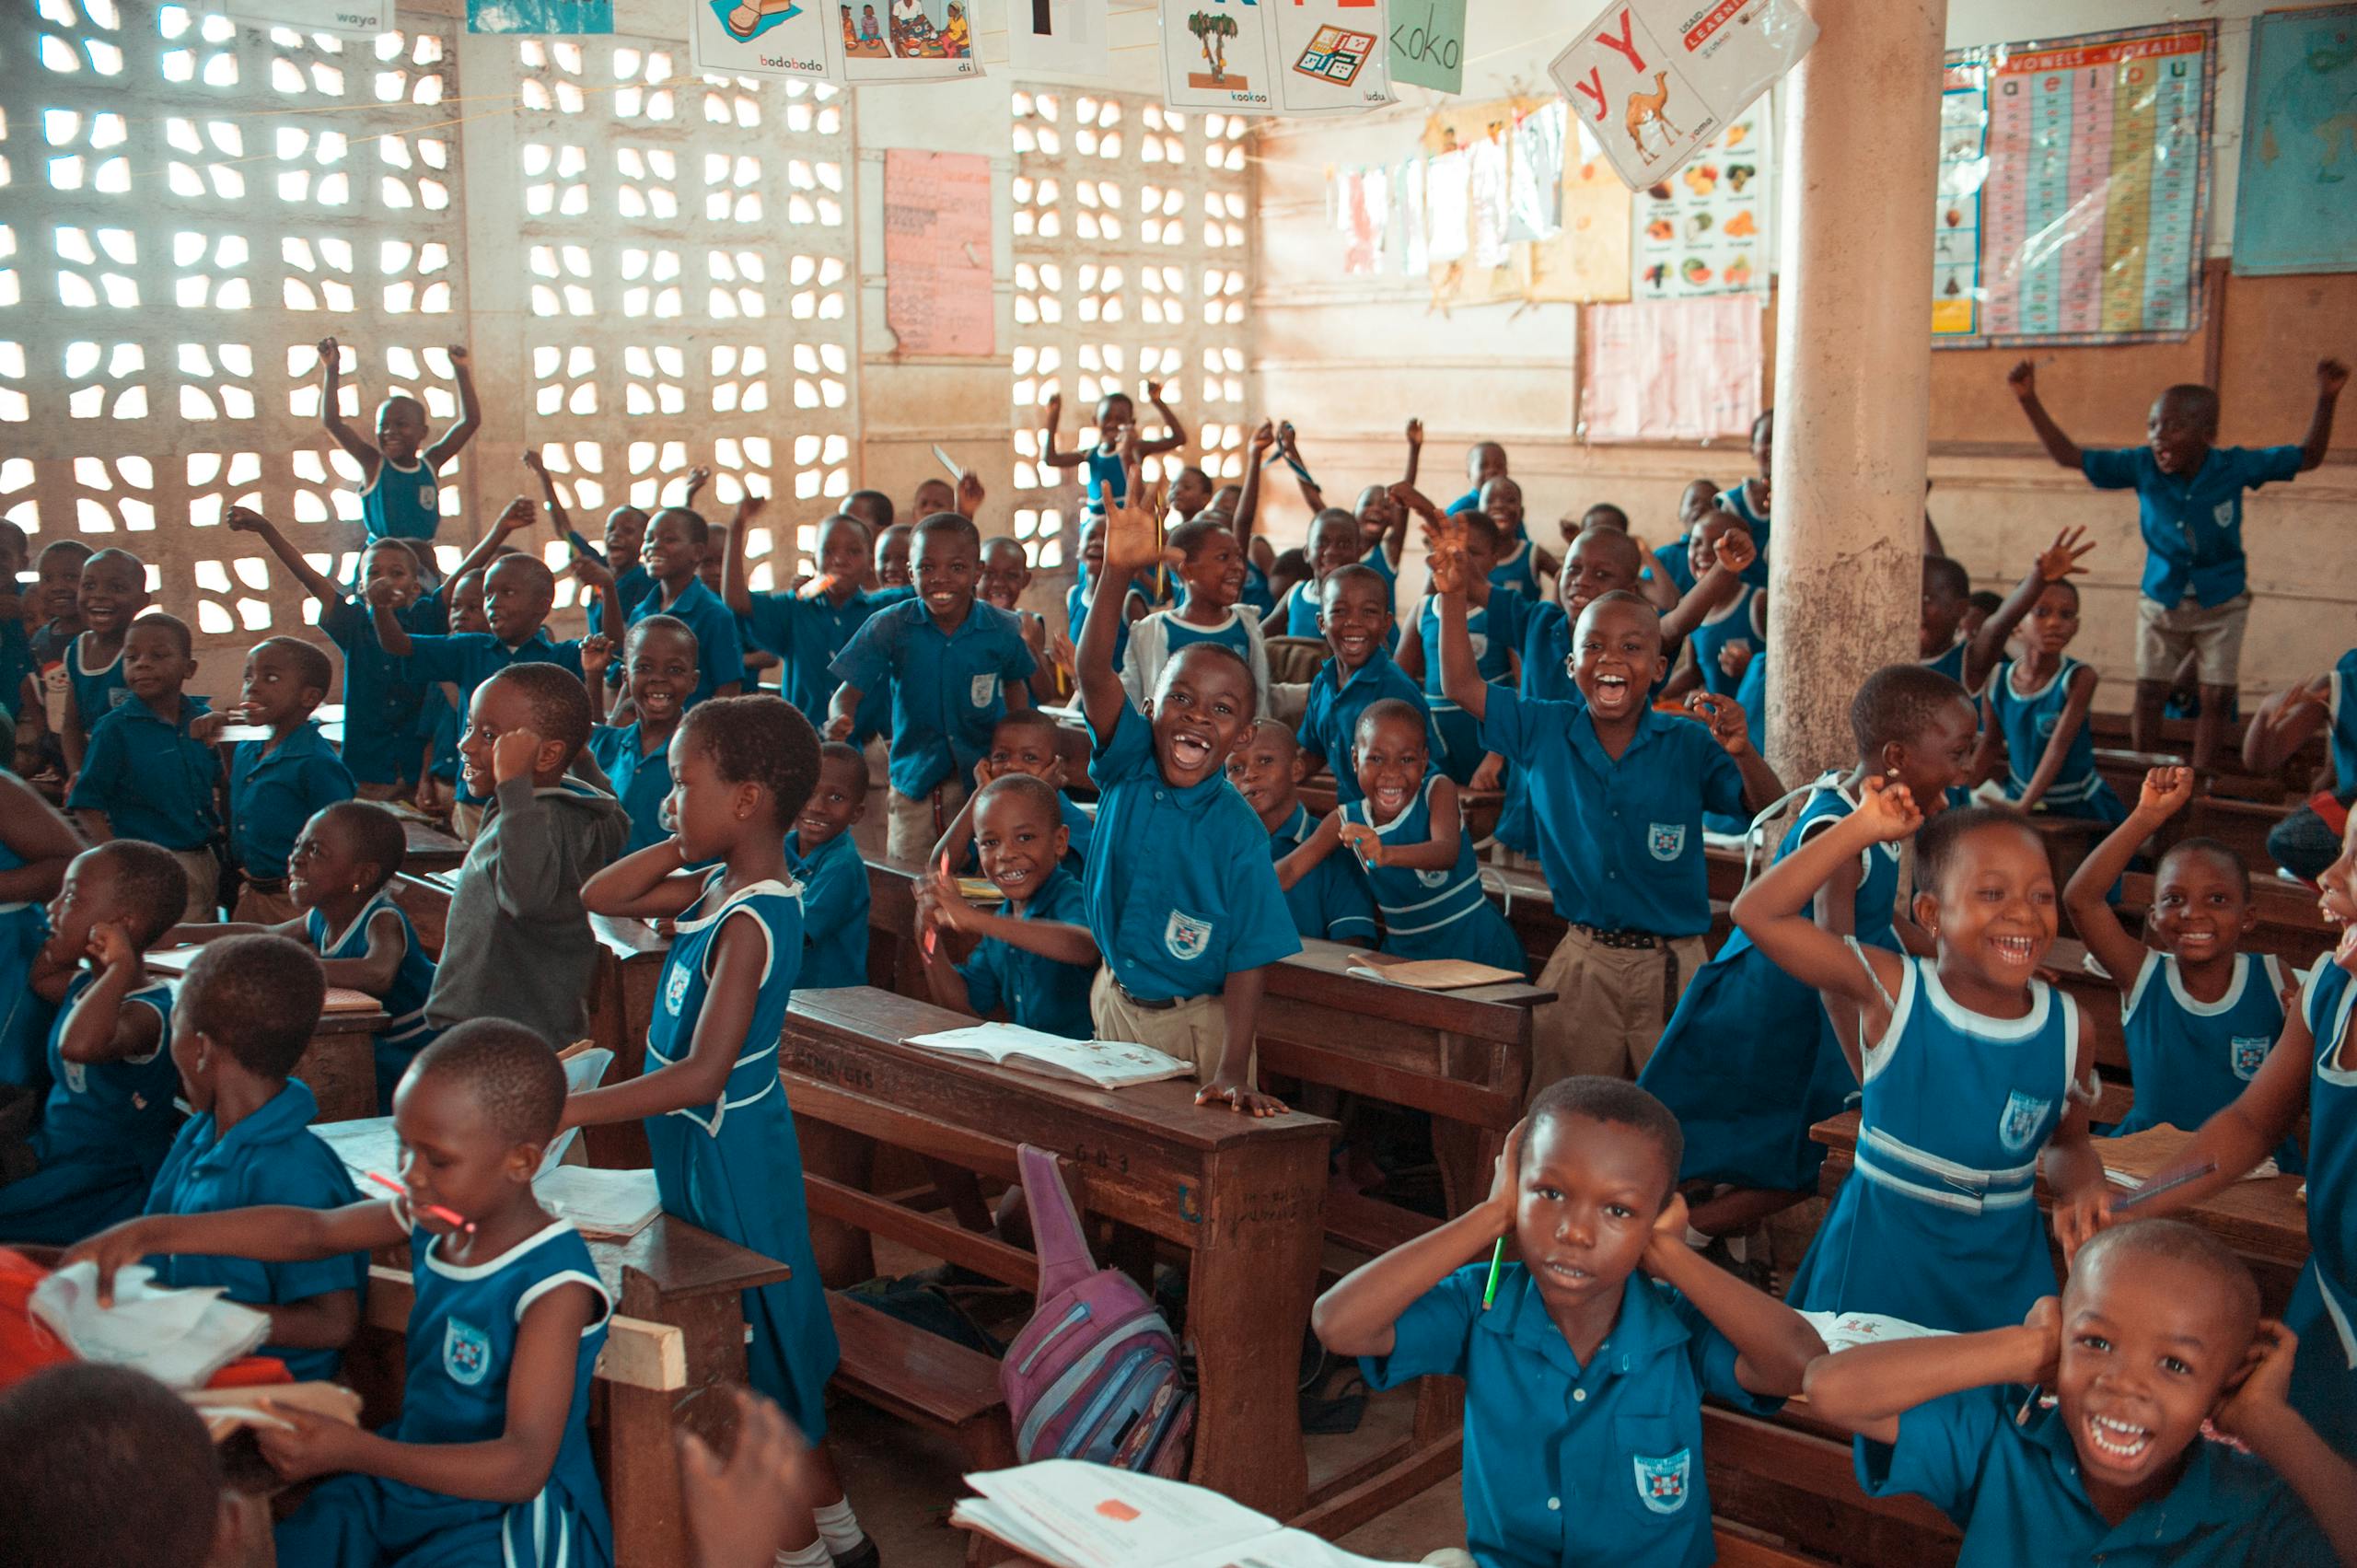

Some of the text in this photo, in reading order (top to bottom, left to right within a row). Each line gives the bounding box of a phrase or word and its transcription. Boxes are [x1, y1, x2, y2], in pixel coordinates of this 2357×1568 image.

[336, 13, 377, 28] waya
[1679, 11, 1703, 34] USAID
[761, 54, 822, 72] bodobodo
[958, 63, 970, 72] di
[2010, 52, 2084, 70] VOWELS
[2003, 81, 2018, 95] a
[2044, 76, 2061, 91] e
[2128, 67, 2143, 84] o
[2171, 61, 2186, 77] u
[1231, 90, 1267, 102] kookoo
[1364, 90, 1386, 101] ludu
[1689, 117, 1713, 141] yoma
